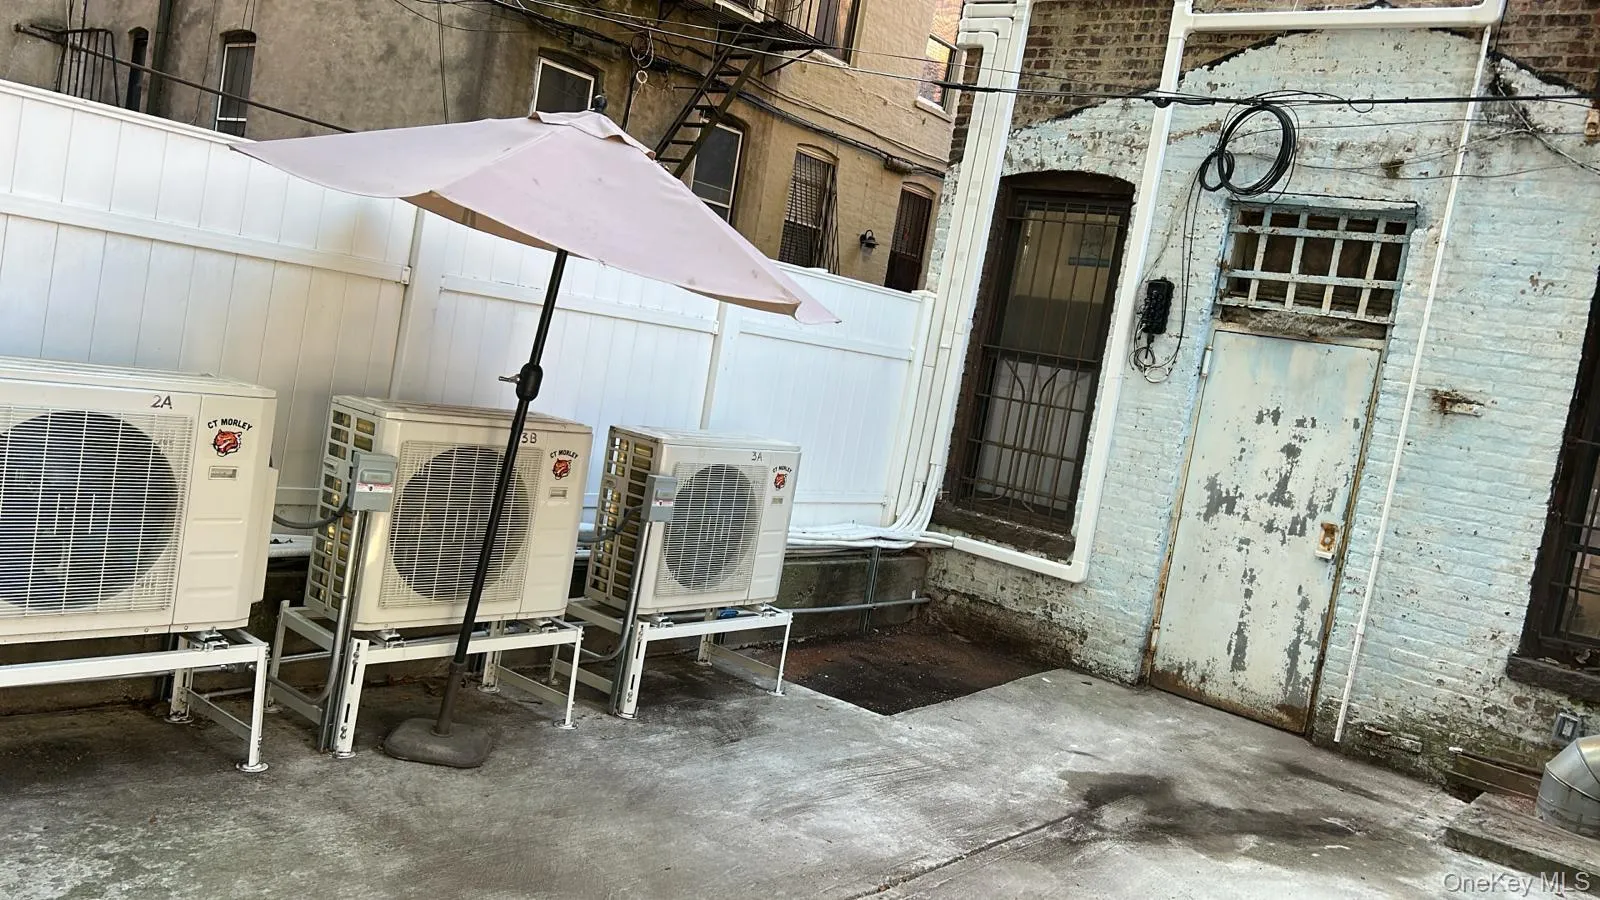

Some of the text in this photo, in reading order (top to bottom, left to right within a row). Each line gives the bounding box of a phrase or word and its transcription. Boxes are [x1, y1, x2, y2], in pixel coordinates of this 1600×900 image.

[151, 394, 172, 409] 2A
[207, 418, 253, 431] CT MORLEY
[521, 432, 537, 444] 3B
[549, 449, 578, 459] CT MORLEY
[751, 451, 763, 461] 3A
